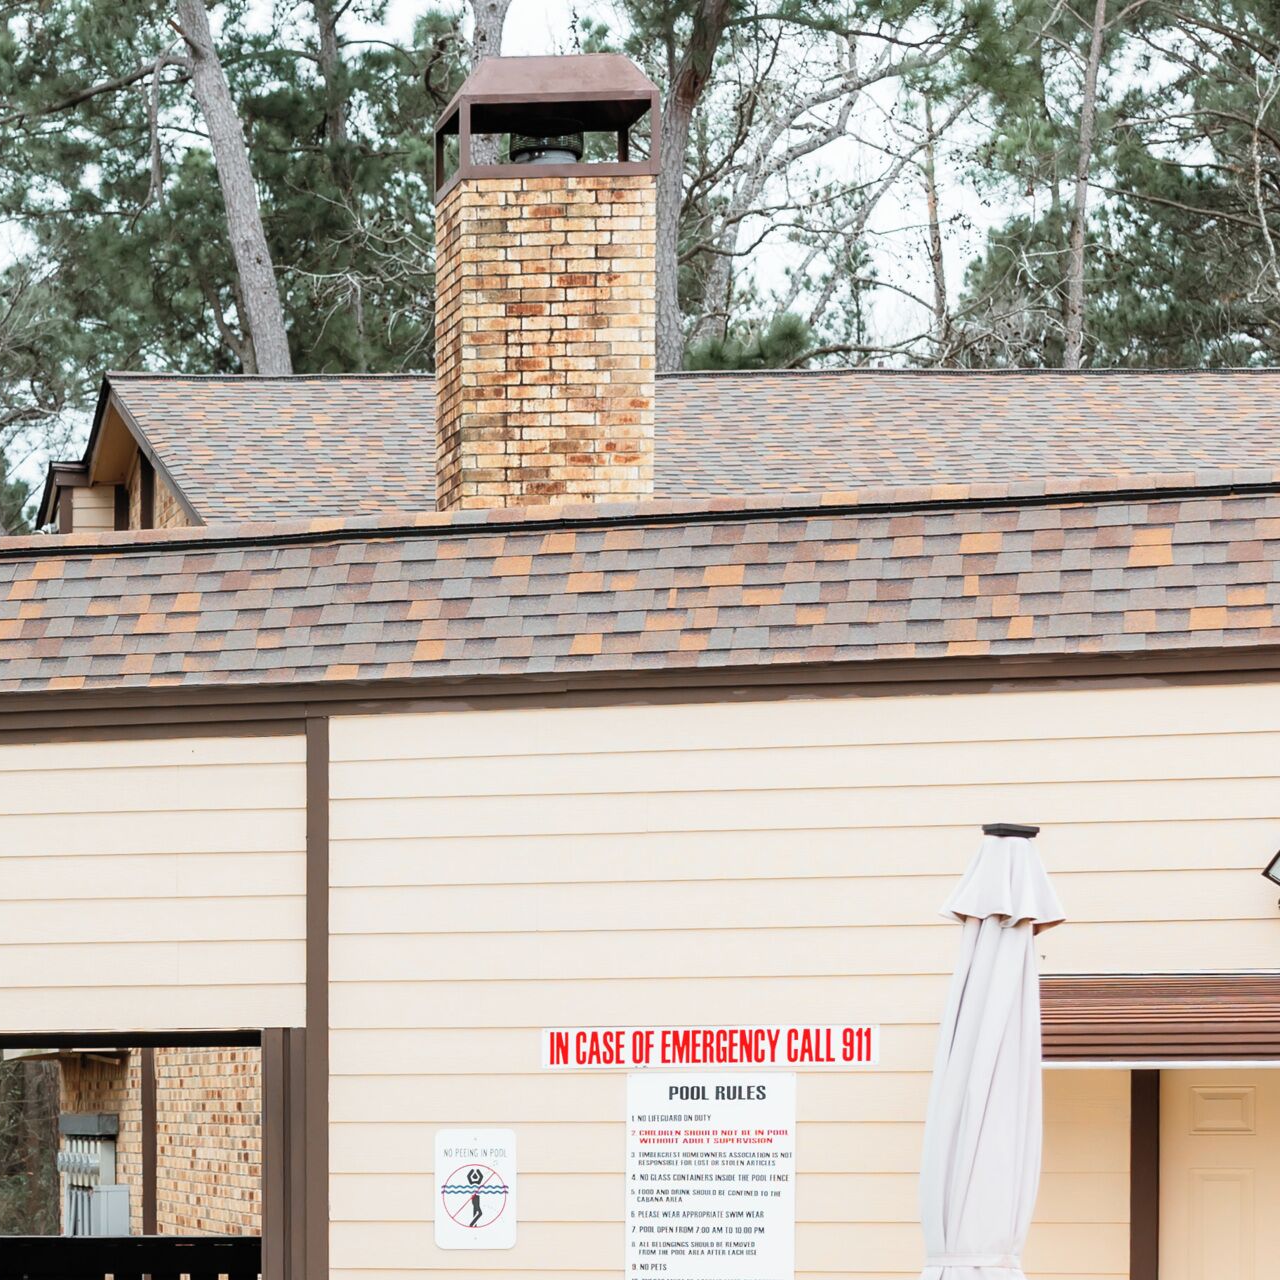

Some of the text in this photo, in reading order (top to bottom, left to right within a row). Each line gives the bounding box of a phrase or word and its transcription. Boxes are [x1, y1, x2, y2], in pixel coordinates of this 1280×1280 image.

[549, 1027, 872, 1065] IN CASE OF EMERGENCY CALL 911
[668, 1085, 766, 1101] POOL RULES
[637, 1114, 647, 1122] NO
[648, 1114, 682, 1122] LIFEGUARD
[684, 1114, 693, 1122] ON
[694, 1114, 711, 1122] DUTY
[640, 1263, 649, 1271] NO
[650, 1263, 667, 1271] PETS
